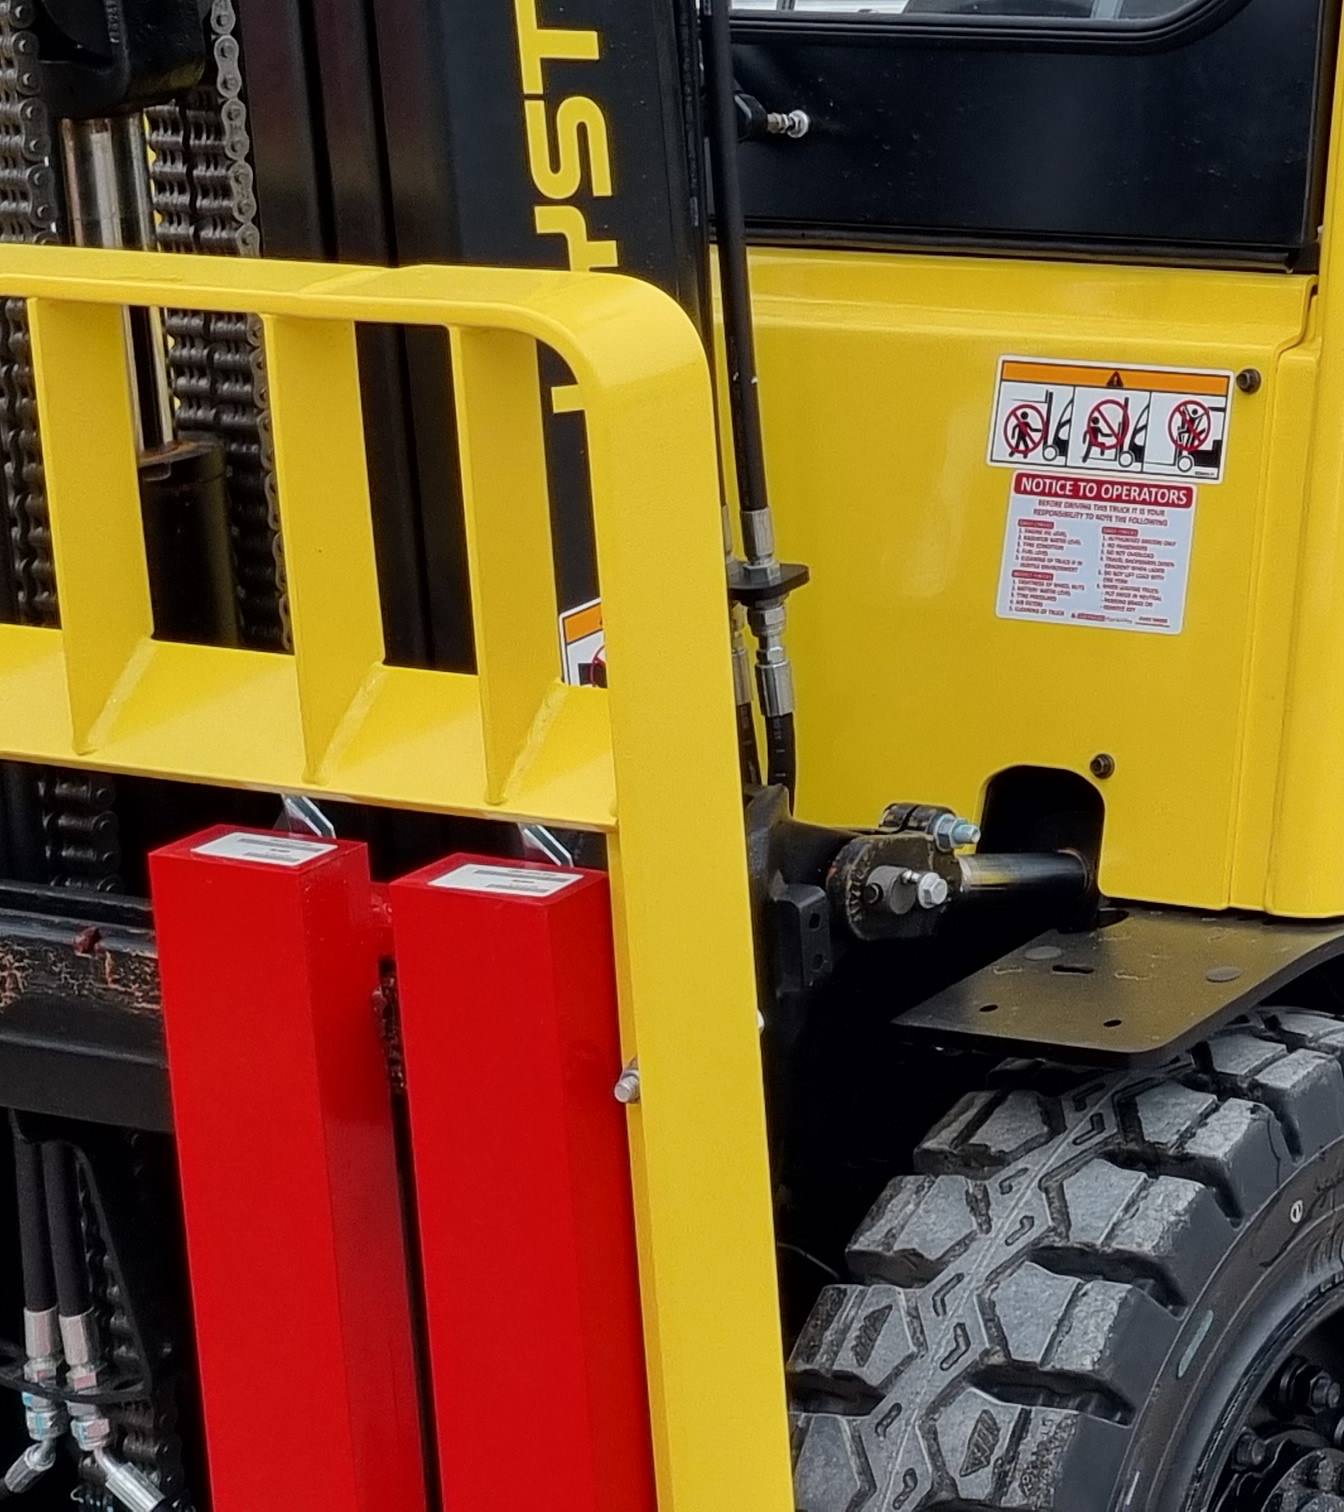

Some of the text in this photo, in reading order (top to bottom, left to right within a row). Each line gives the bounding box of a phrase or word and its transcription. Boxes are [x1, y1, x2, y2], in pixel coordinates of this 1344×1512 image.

[1020, 477, 1188, 505] NOTICE TO OPERATORS
